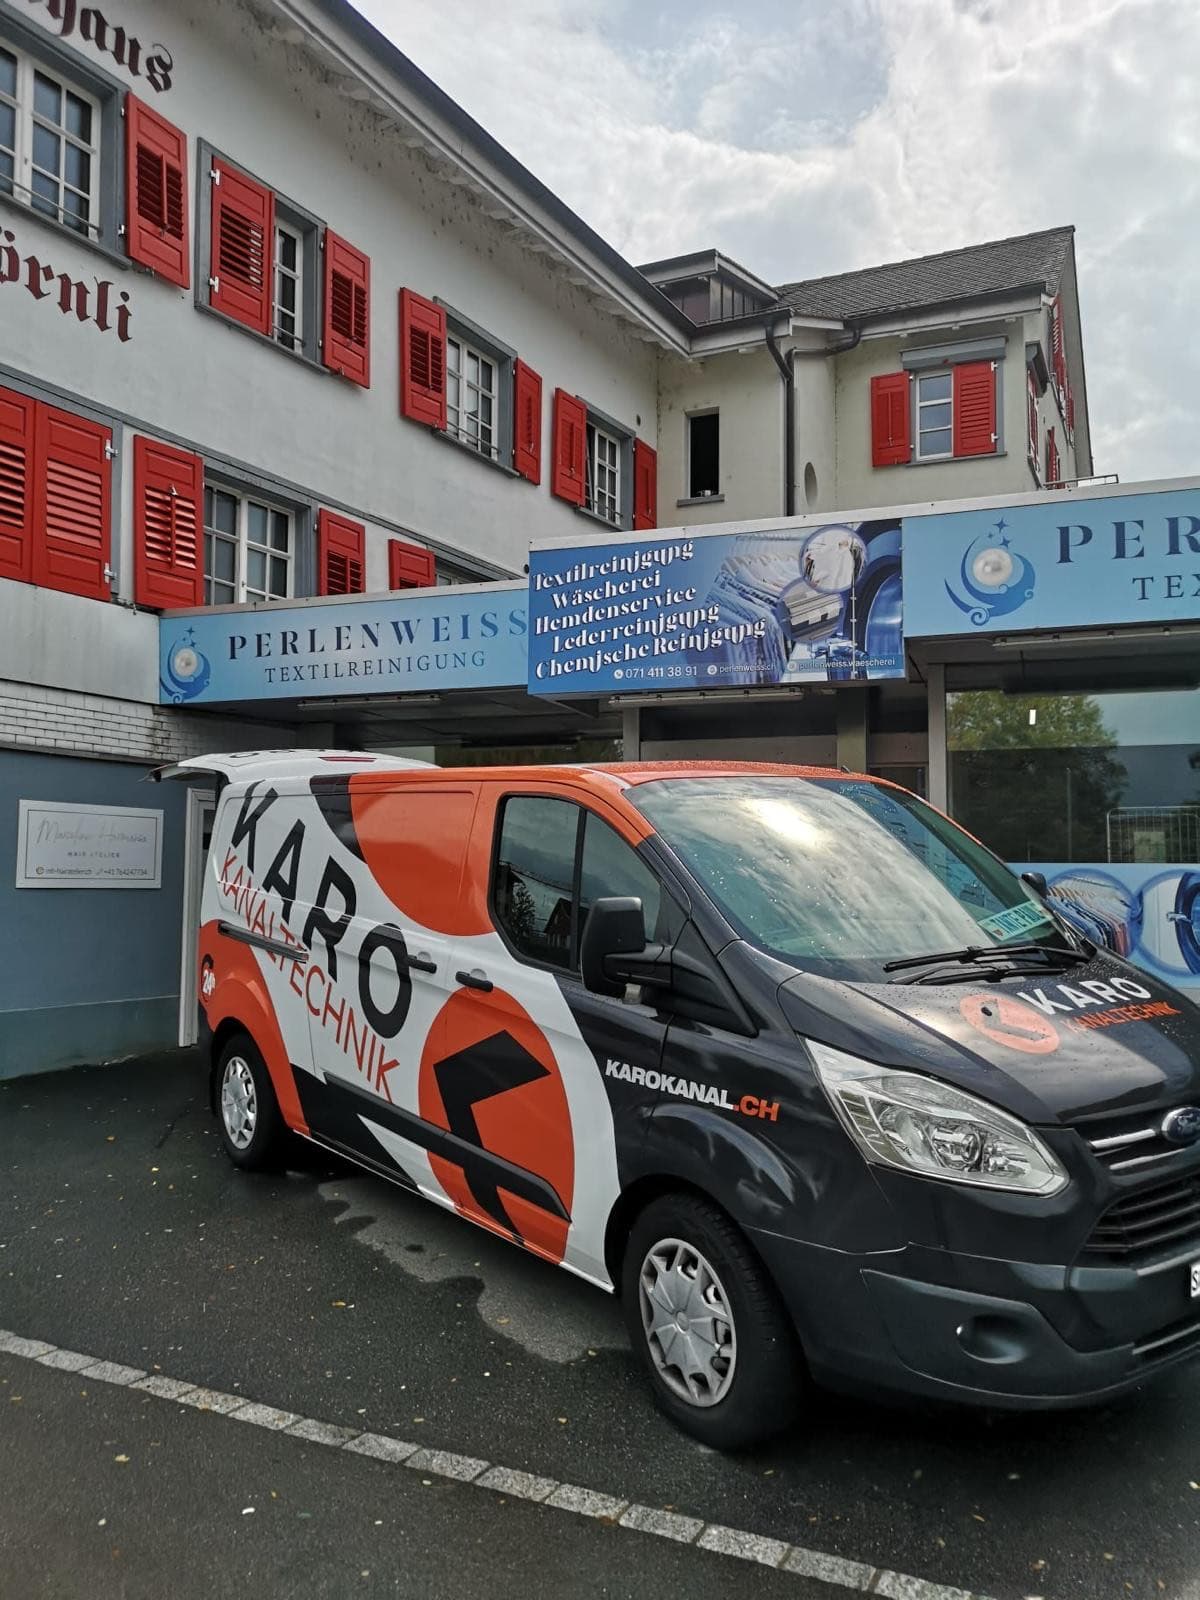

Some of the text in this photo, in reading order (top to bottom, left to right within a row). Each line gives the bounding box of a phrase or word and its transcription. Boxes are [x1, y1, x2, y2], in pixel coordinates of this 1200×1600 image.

[532, 540, 694, 591] Textilreinigung
[552, 570, 661, 609] Wäscherei
[228, 608, 528, 660] PERLENWEISS
[535, 587, 697, 635] Hemdenservice
[553, 604, 720, 653] Lederreinigung
[265, 650, 486, 684] TEXTILREINIGUNG
[536, 618, 767, 680] Chemische Reinigung
[625, 665, 698, 680] 071 411 38 91
[231, 780, 412, 1038] KARO
[220, 846, 400, 1104] KANALTECHNIK
[1017, 977, 1151, 1015] KARO
[1060, 999, 1183, 1034] KANALTECHNIK
[605, 1059, 780, 1121] KAROKANAL.CH
